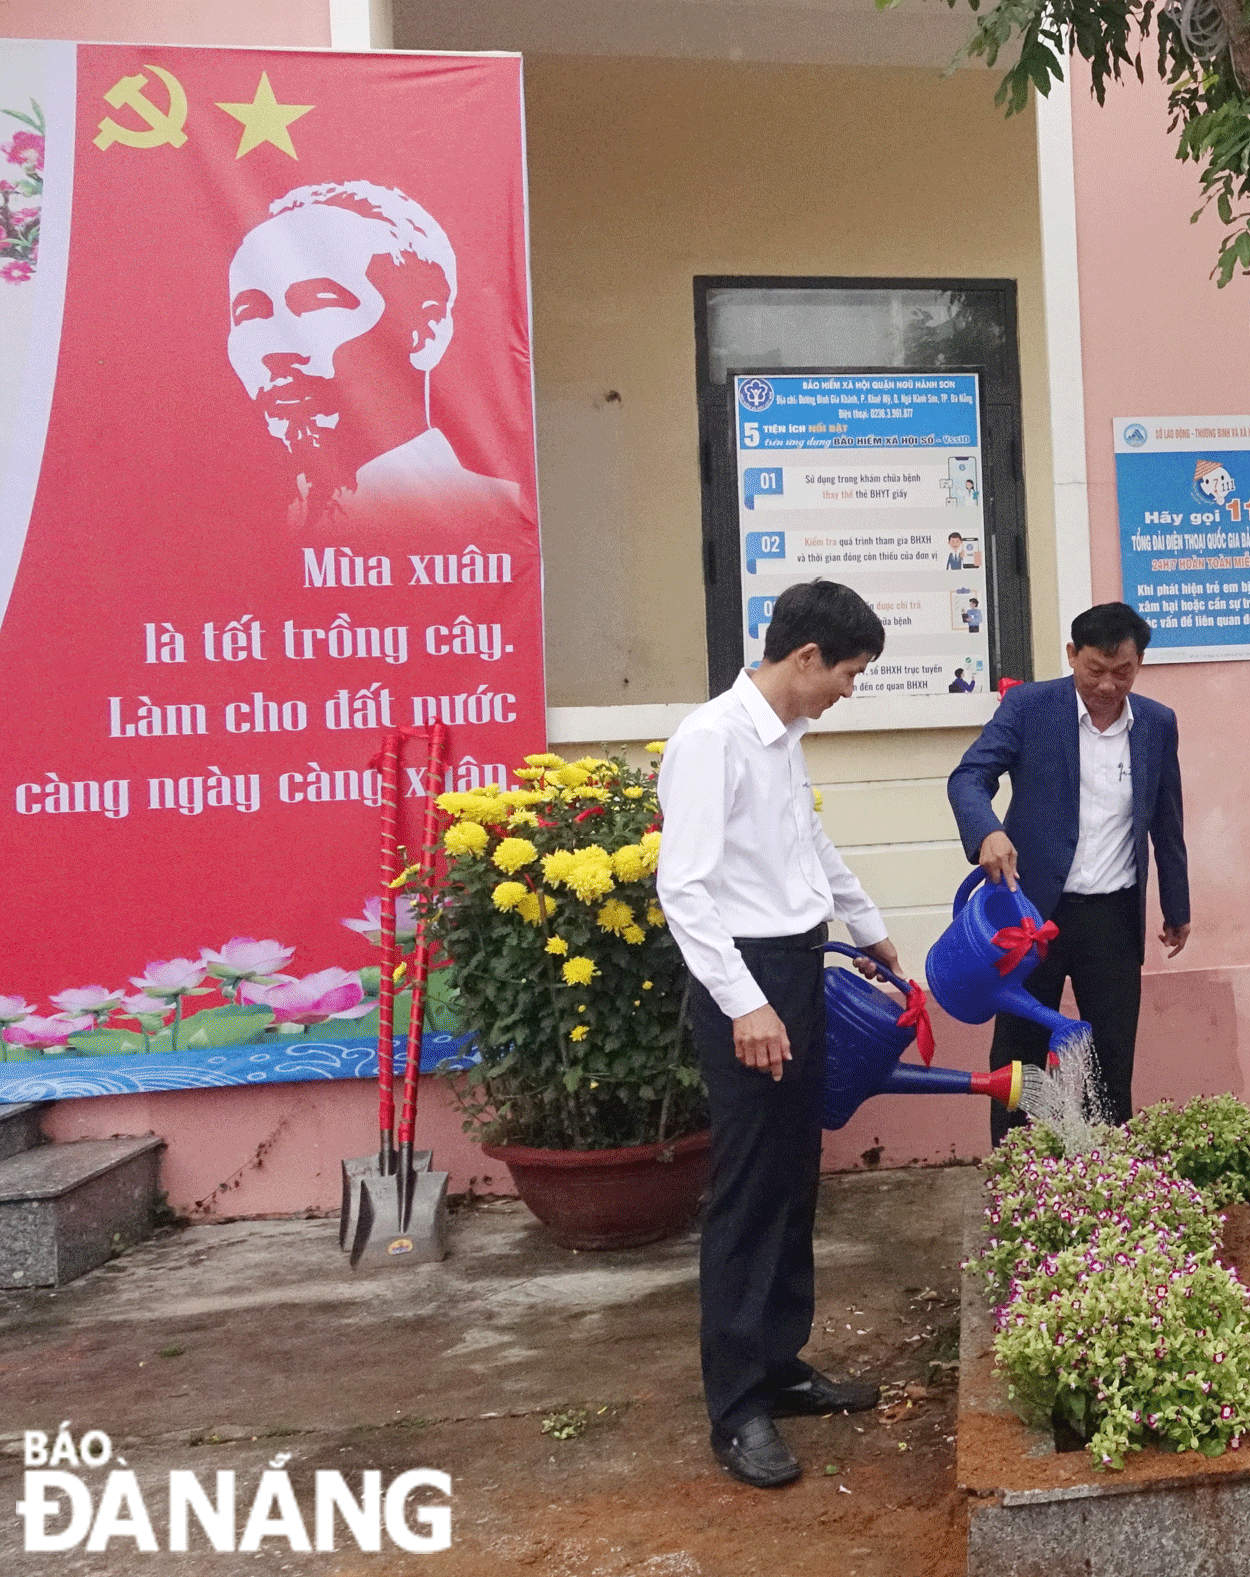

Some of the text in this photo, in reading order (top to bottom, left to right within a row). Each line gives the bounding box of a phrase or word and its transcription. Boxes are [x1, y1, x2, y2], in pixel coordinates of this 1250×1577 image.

[802, 378, 955, 391] BẢO HIỂM XÃ HỘI QUẬN NGŨ HÀNH SƠN
[743, 422, 760, 447] 5
[763, 424, 786, 434] TIỆN
[788, 424, 806, 433] ÍCH
[832, 435, 854, 446] BẢO
[855, 434, 882, 446] HIỂM
[884, 435, 898, 445] XÃ
[900, 435, 918, 446] HỘI
[919, 433, 935, 444] SỐ
[760, 473, 776, 489] 01
[804, 472, 921, 486] Sử dụng trong khám chữa bệnh
[854, 488, 868, 500] thẻ
[869, 488, 890, 500] BHYT
[891, 488, 908, 500] giấy
[1144, 510, 1183, 526] Hãy
[1189, 510, 1220, 525] gọi
[761, 536, 780, 552] 02
[838, 534, 853, 546] quá
[853, 534, 874, 546] trình
[874, 533, 895, 546] tham
[895, 533, 908, 546] gia
[909, 533, 932, 545] BHXH
[1131, 527, 1151, 551] TỔNG
[1151, 530, 1165, 550] ĐÀI
[1165, 530, 1182, 554] ĐIỆN
[1184, 533, 1205, 553] THOẠI
[1206, 526, 1226, 549] QUỐC
[1227, 532, 1240, 549] GIA
[796, 549, 938, 564] và thời gian đóng còn thiếu của đơn vị
[1178, 555, 1205, 570] HOÀN
[1207, 554, 1232, 570] TOÀN
[302, 544, 514, 589] Mùa xuân
[1137, 583, 1153, 596] Khi
[1156, 582, 1178, 596] phát
[1181, 582, 1202, 596] hiện
[1206, 581, 1219, 594] trẻ
[1222, 583, 1238, 593] em
[1241, 581, 1250, 594] bị
[764, 601, 776, 617] 0
[1138, 599, 1159, 613] xâm
[1162, 599, 1178, 613] hại
[1180, 598, 1205, 612] hoặc
[1207, 597, 1226, 611] cần
[1228, 597, 1240, 610] sự
[893, 616, 912, 627] bệnh
[1145, 616, 1158, 628] ác
[1159, 615, 1178, 629] vấn
[1180, 614, 1192, 628] đề
[1194, 613, 1214, 627] liên
[1216, 612, 1240, 627] quan
[143, 612, 514, 666] là tết trồng cây.
[869, 664, 878, 677] sổ
[879, 663, 902, 676] BHXH
[903, 662, 919, 676] trực
[921, 661, 942, 676] tuyến
[859, 682, 874, 692] đến
[874, 680, 884, 692] cơ
[885, 679, 904, 692] quan
[905, 678, 928, 691] BHXH
[107, 682, 516, 738] Làm cho đất nước
[15, 771, 130, 820] càng
[147, 765, 260, 816] ngày
[279, 761, 382, 806] càng
